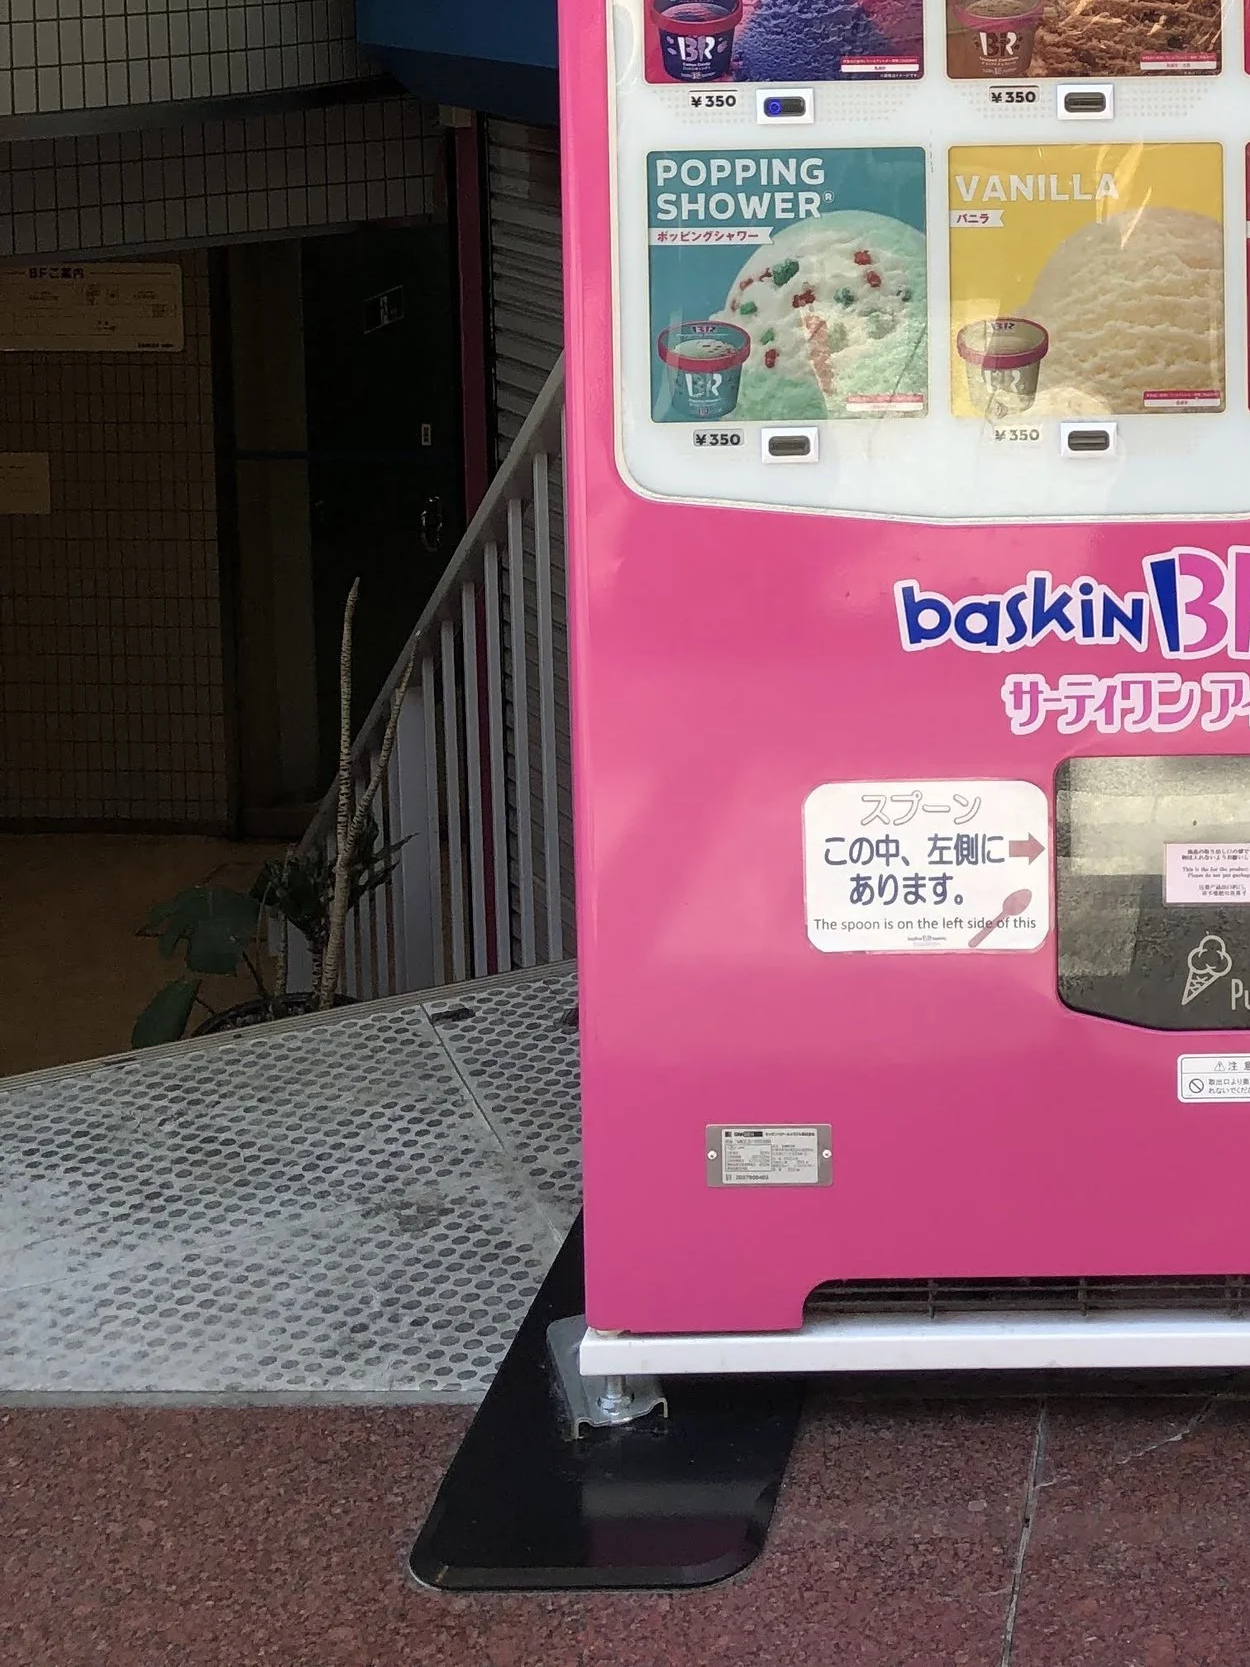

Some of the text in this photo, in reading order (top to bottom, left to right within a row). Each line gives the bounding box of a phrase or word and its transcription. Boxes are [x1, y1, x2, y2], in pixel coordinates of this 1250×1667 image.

[691, 94, 736, 108] ¥350
[991, 90, 1036, 104] ¥350
[656, 157, 825, 186] POPPING
[955, 174, 1119, 202] VANILLA
[957, 213, 989, 224] バニラ
[657, 231, 759, 243] ポッピングシャワー
[695, 433, 740, 446] ¥350
[996, 429, 1039, 442] ¥350
[901, 576, 1146, 652] baskin
[861, 790, 982, 826] スプーン
[849, 872, 964, 906] あります。
[814, 917, 1036, 932] The spoon is on the left side of this
